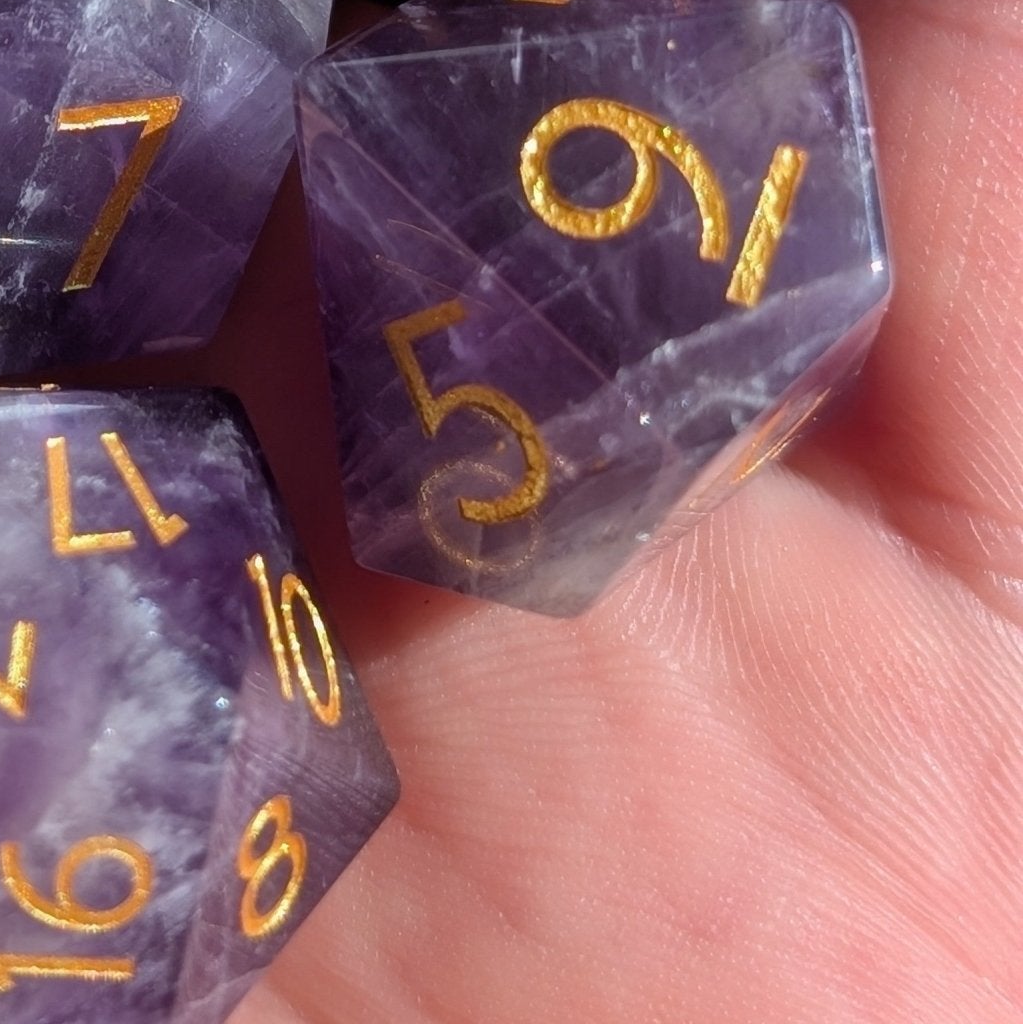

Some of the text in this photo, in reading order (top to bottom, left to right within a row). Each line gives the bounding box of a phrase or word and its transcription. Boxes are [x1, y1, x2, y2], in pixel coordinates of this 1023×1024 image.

[57, 95, 183, 293] 7
[45, 431, 190, 559] 17
[383, 298, 549, 525] 5
[246, 552, 342, 727] 10
[239, 794, 308, 939] 8
